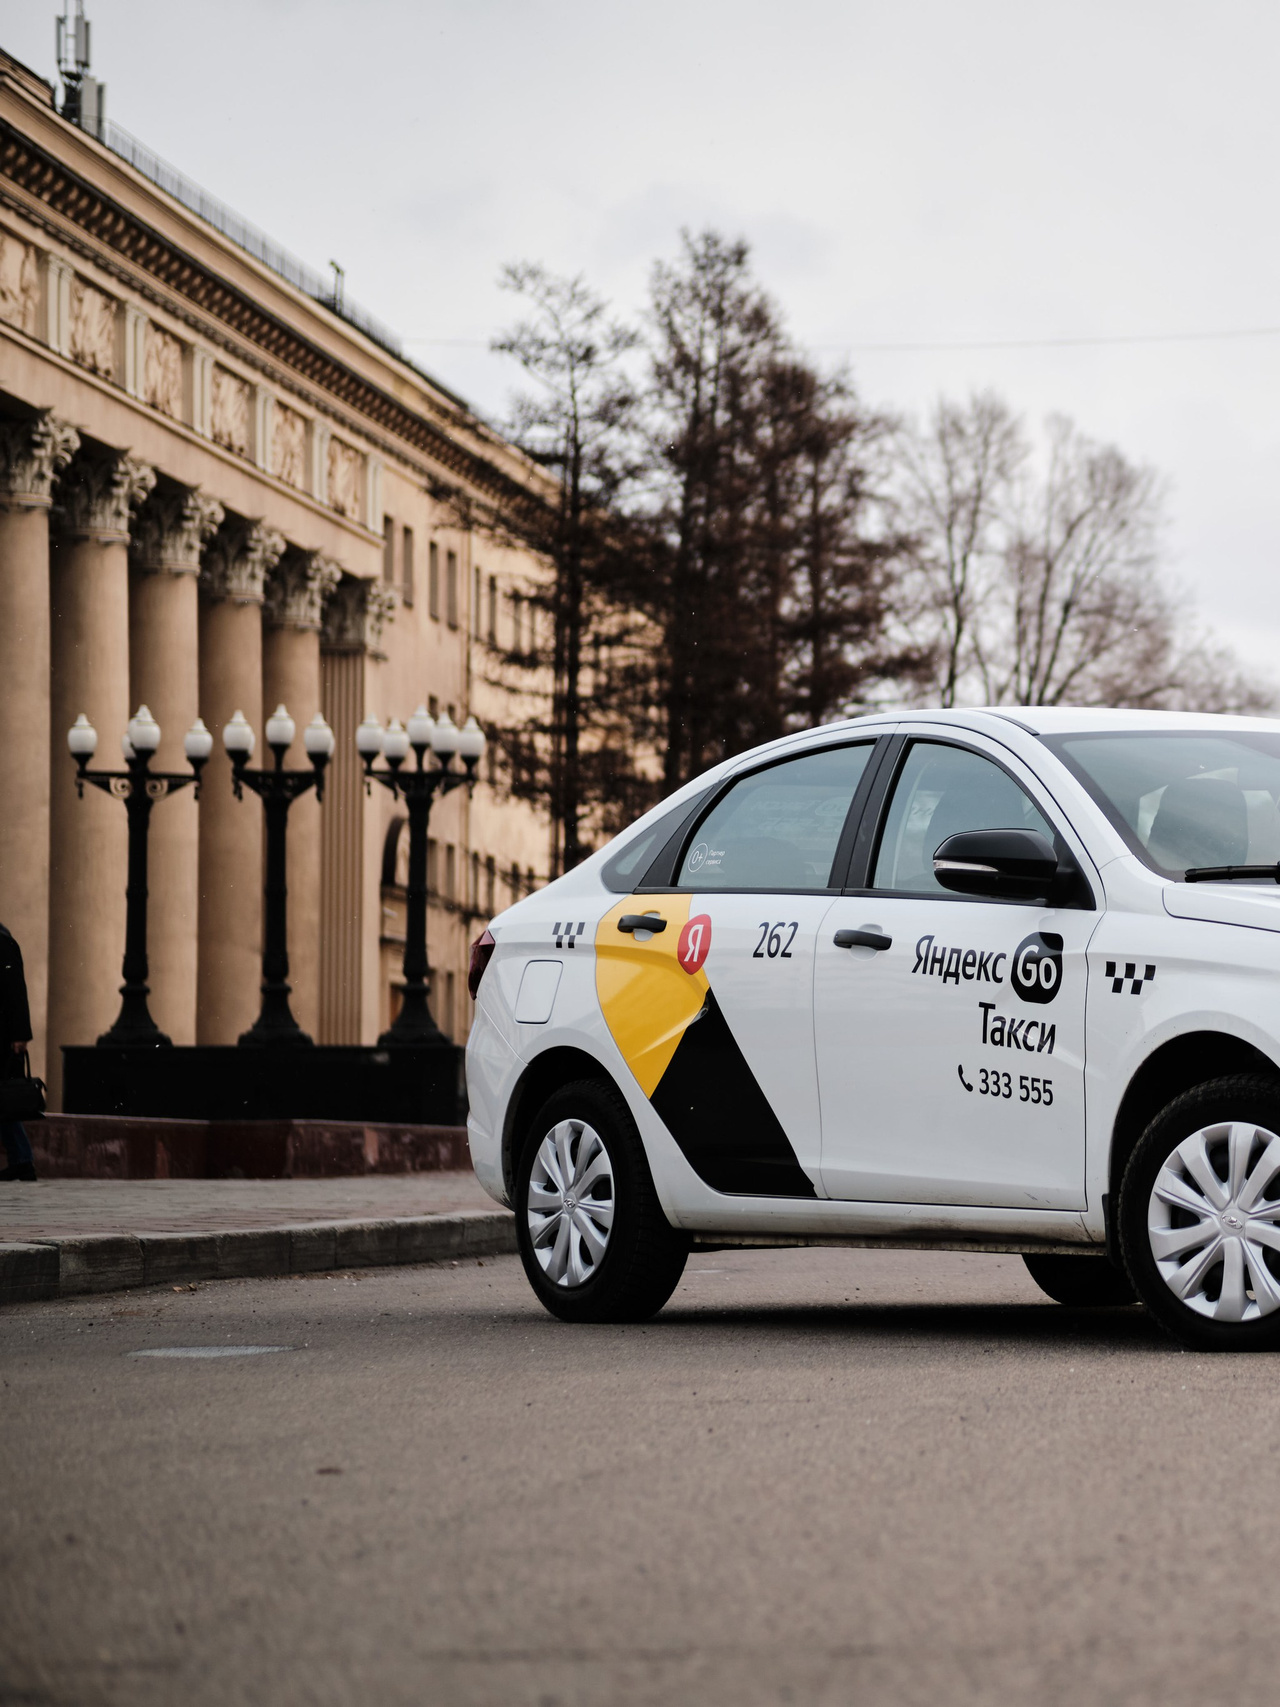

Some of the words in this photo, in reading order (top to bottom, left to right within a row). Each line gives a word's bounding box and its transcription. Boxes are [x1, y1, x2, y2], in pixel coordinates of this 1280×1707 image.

[683, 924, 704, 962] Я
[752, 921, 799, 958] 262
[911, 935, 1007, 985] Яндекс
[1016, 944, 1057, 990] Go
[978, 1001, 1056, 1055] Такси
[978, 1068, 1013, 1099] 333
[1019, 1075, 1054, 1106] 555
